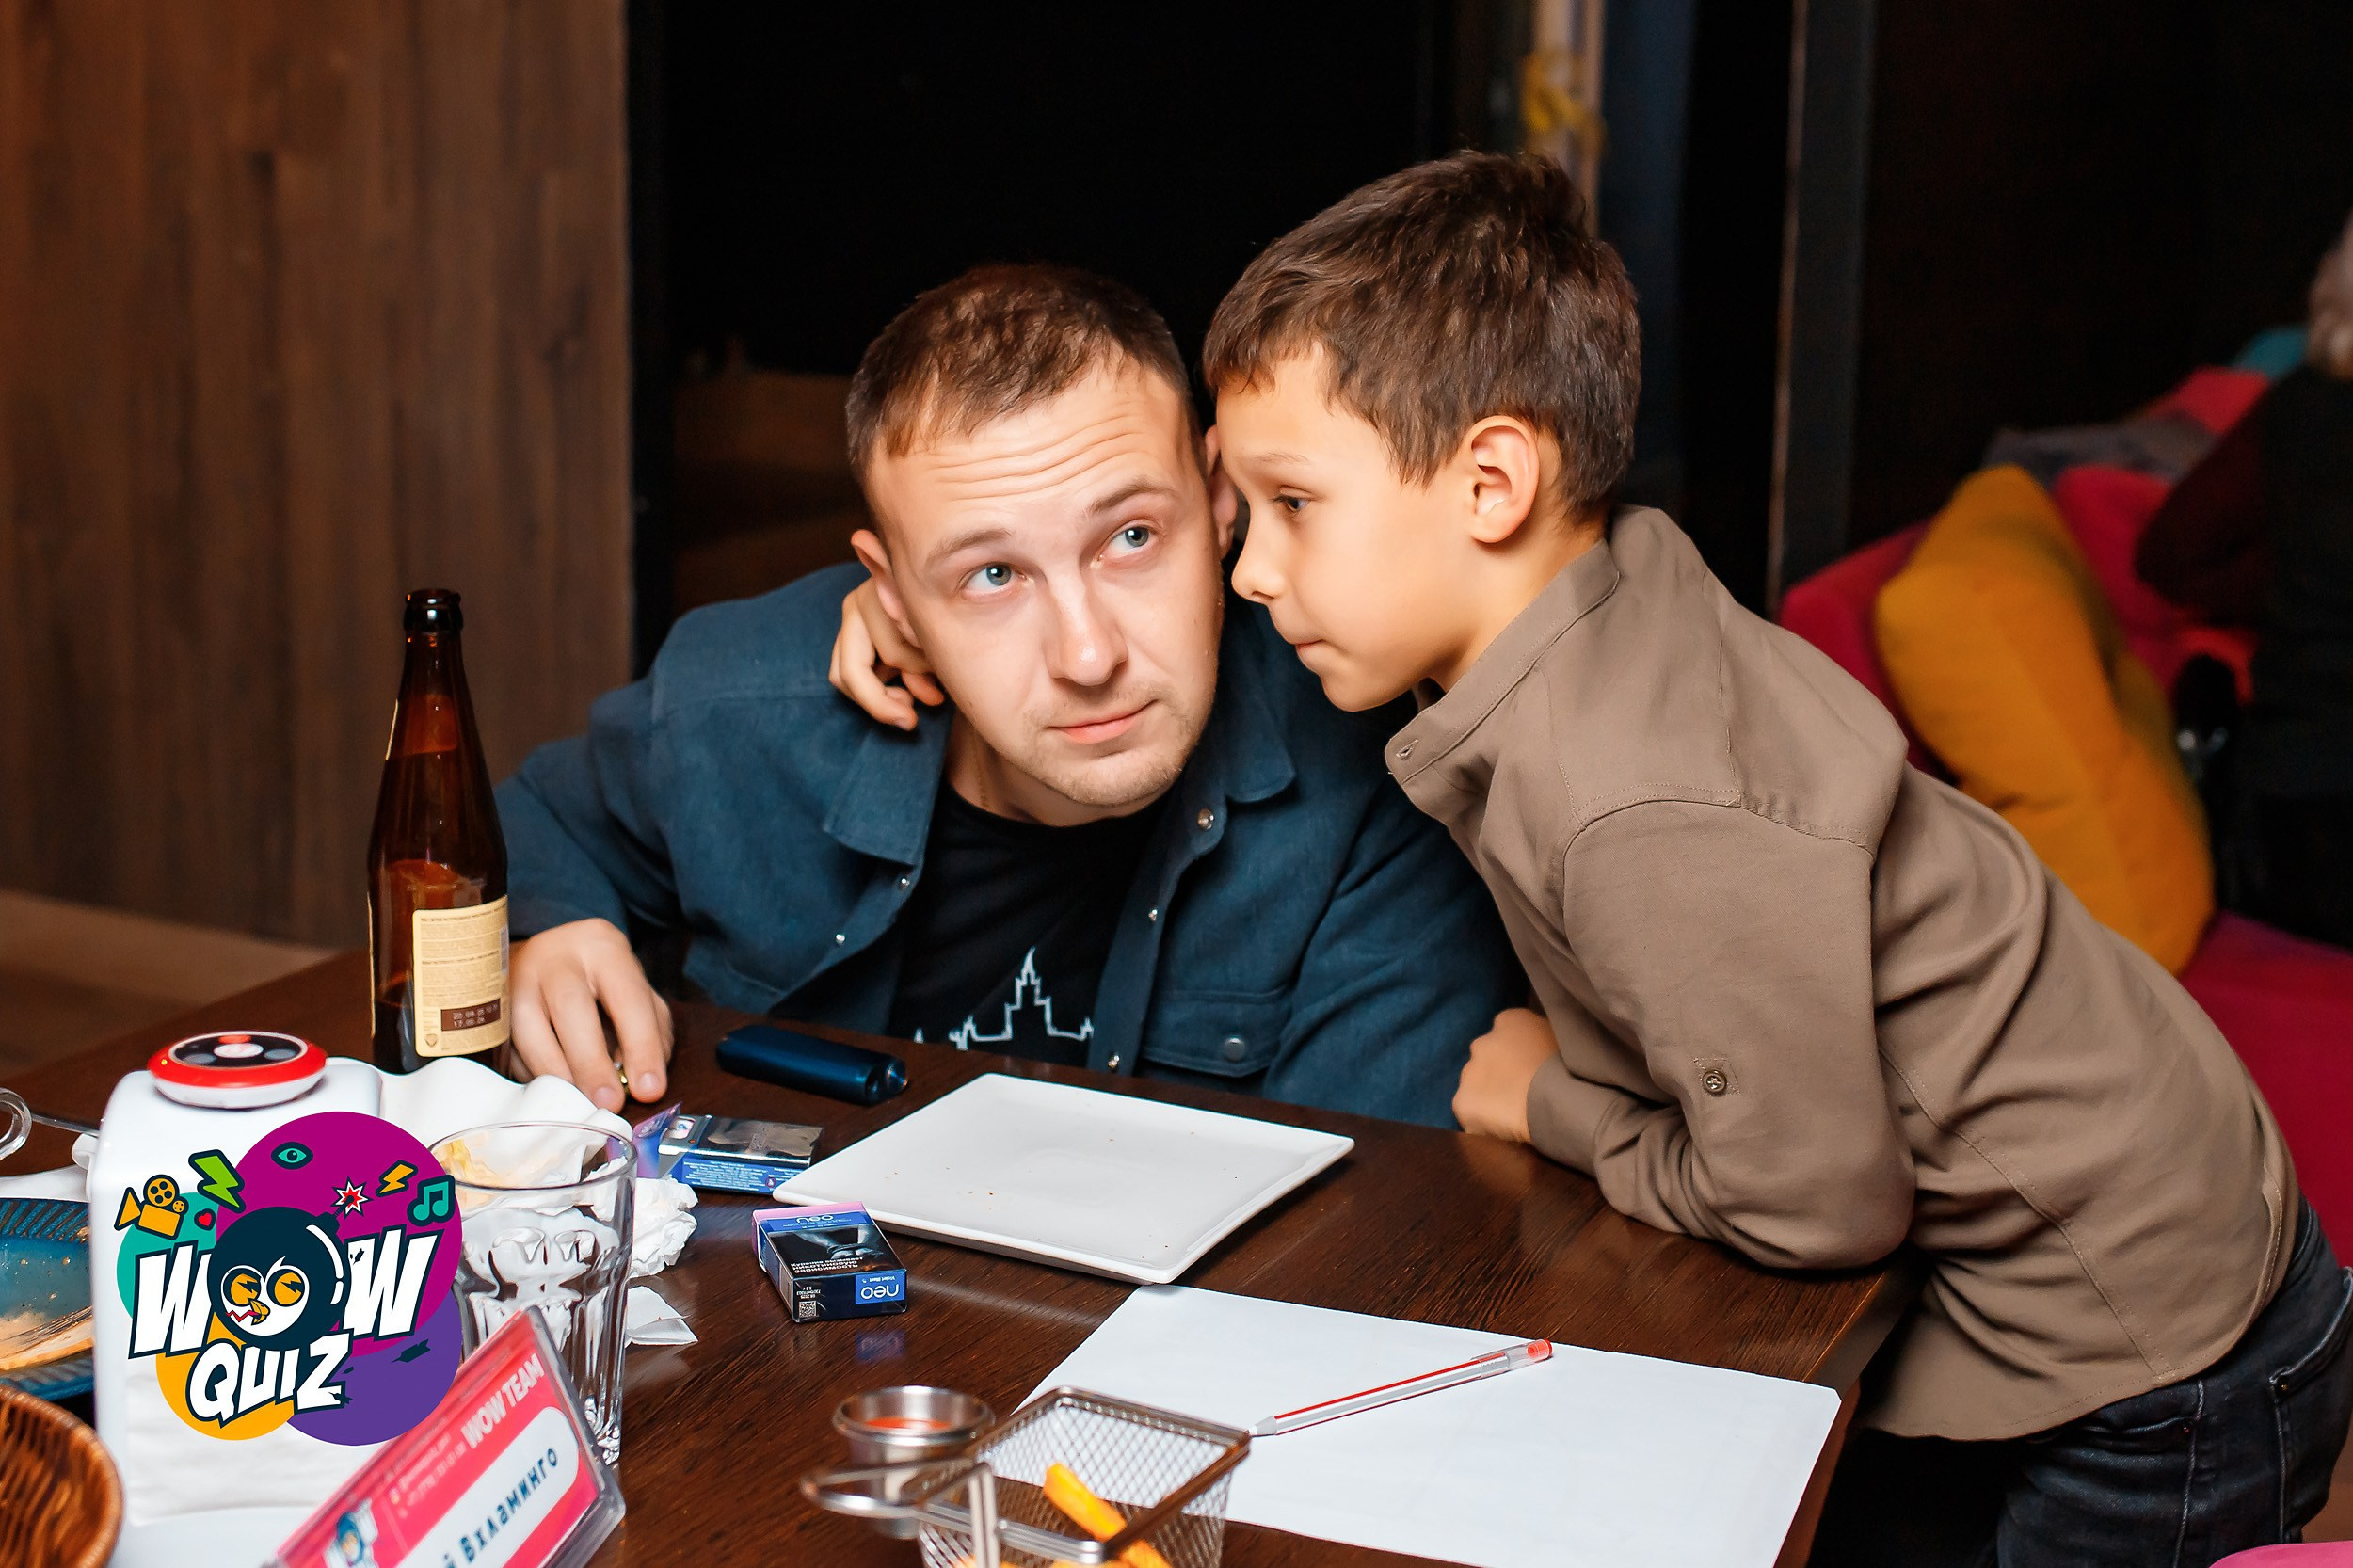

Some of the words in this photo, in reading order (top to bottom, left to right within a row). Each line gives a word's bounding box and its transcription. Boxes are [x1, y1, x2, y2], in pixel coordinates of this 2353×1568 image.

[796, 1215, 833, 1224] neo
[860, 1283, 900, 1300] neo
[460, 1390, 507, 1449] WOW
[501, 1352, 545, 1408] TEAM
